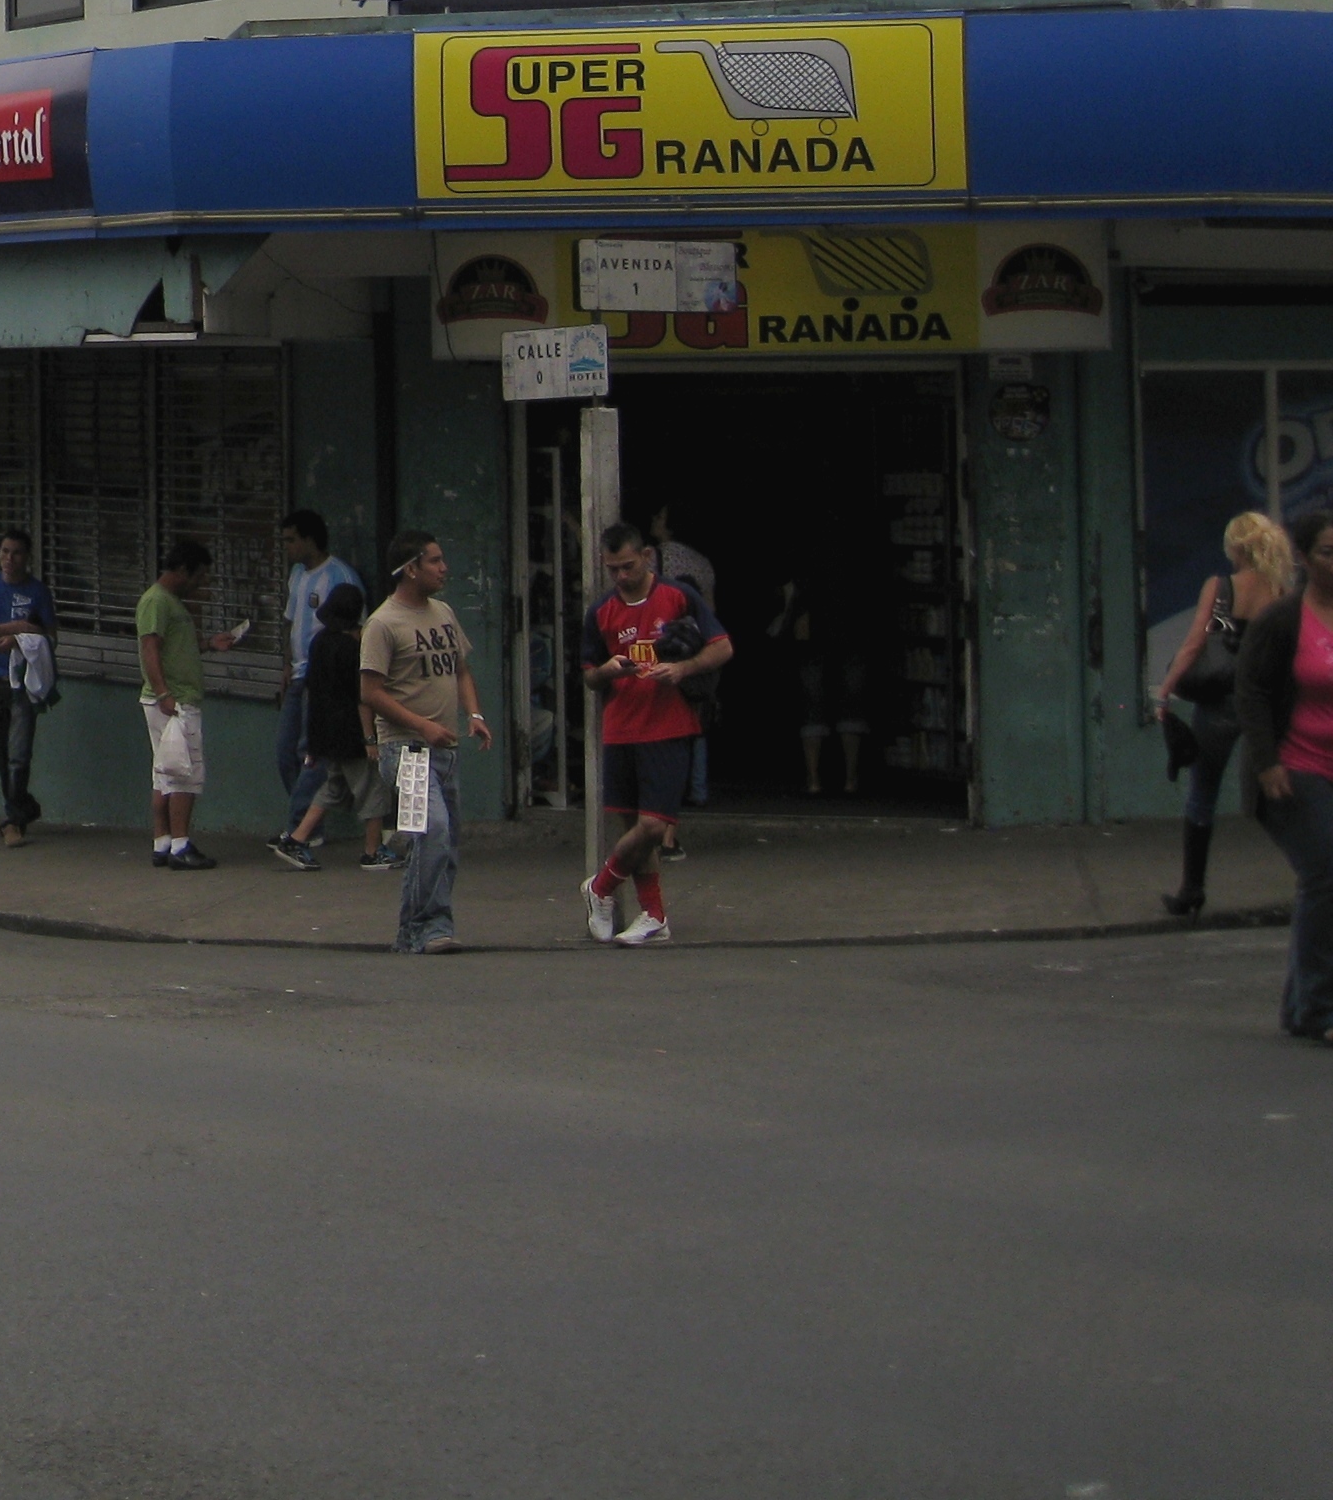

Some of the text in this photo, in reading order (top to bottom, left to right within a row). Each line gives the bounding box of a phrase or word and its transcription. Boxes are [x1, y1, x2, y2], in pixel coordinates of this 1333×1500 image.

[600, 258, 674, 271] AVENIDA
[632, 282, 639, 296] 1
[1018, 272, 1069, 292] ZAR
[467, 281, 517, 301] ZAR
[518, 343, 561, 360] CALLE
[569, 371, 606, 381] HOTEL
